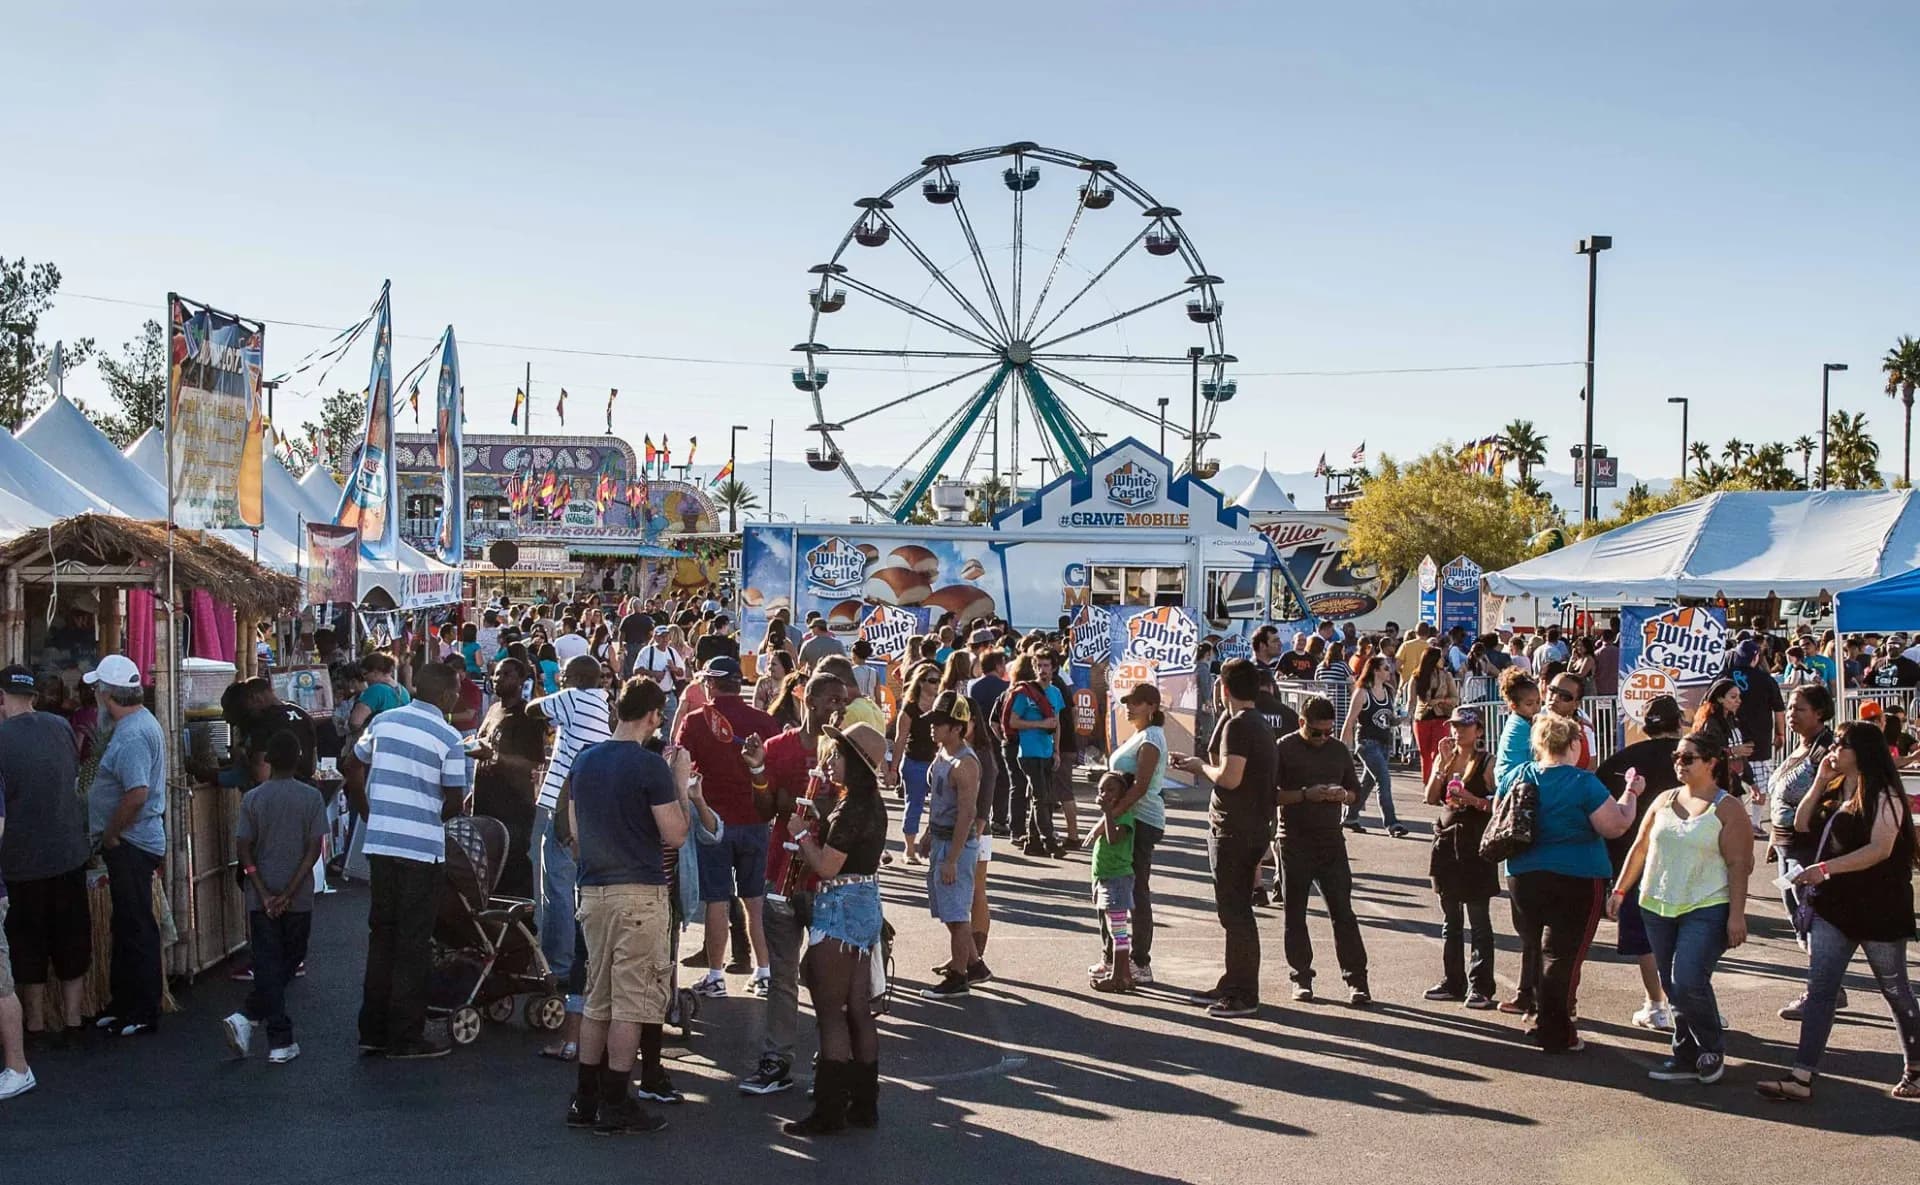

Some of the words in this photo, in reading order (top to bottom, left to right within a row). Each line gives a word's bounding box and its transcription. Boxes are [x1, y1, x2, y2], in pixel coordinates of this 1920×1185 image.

[503, 446, 592, 470] GRAS
[1112, 474, 1150, 489] White
[1109, 486, 1153, 500] Castle
[519, 527, 572, 537] WATER
[572, 528, 607, 536] GUN
[608, 528, 640, 538] FUN
[1250, 523, 1328, 545] Miller
[815, 552, 858, 569] White
[812, 566, 859, 581] Castle
[1449, 567, 1478, 578] White
[1446, 577, 1478, 587] Castle
[866, 619, 910, 641] White
[1075, 621, 1110, 643] White
[1137, 620, 1194, 648] White
[1653, 622, 1721, 654] White
[1073, 637, 1111, 662] Castle
[1130, 639, 1194, 667] Castle
[1223, 643, 1250, 651] White
[1646, 644, 1720, 678] Castle
[1119, 665, 1147, 679] 30
[1631, 674, 1666, 689] 30
[1078, 694, 1091, 707] 10
[1079, 707, 1096, 718] ACK
